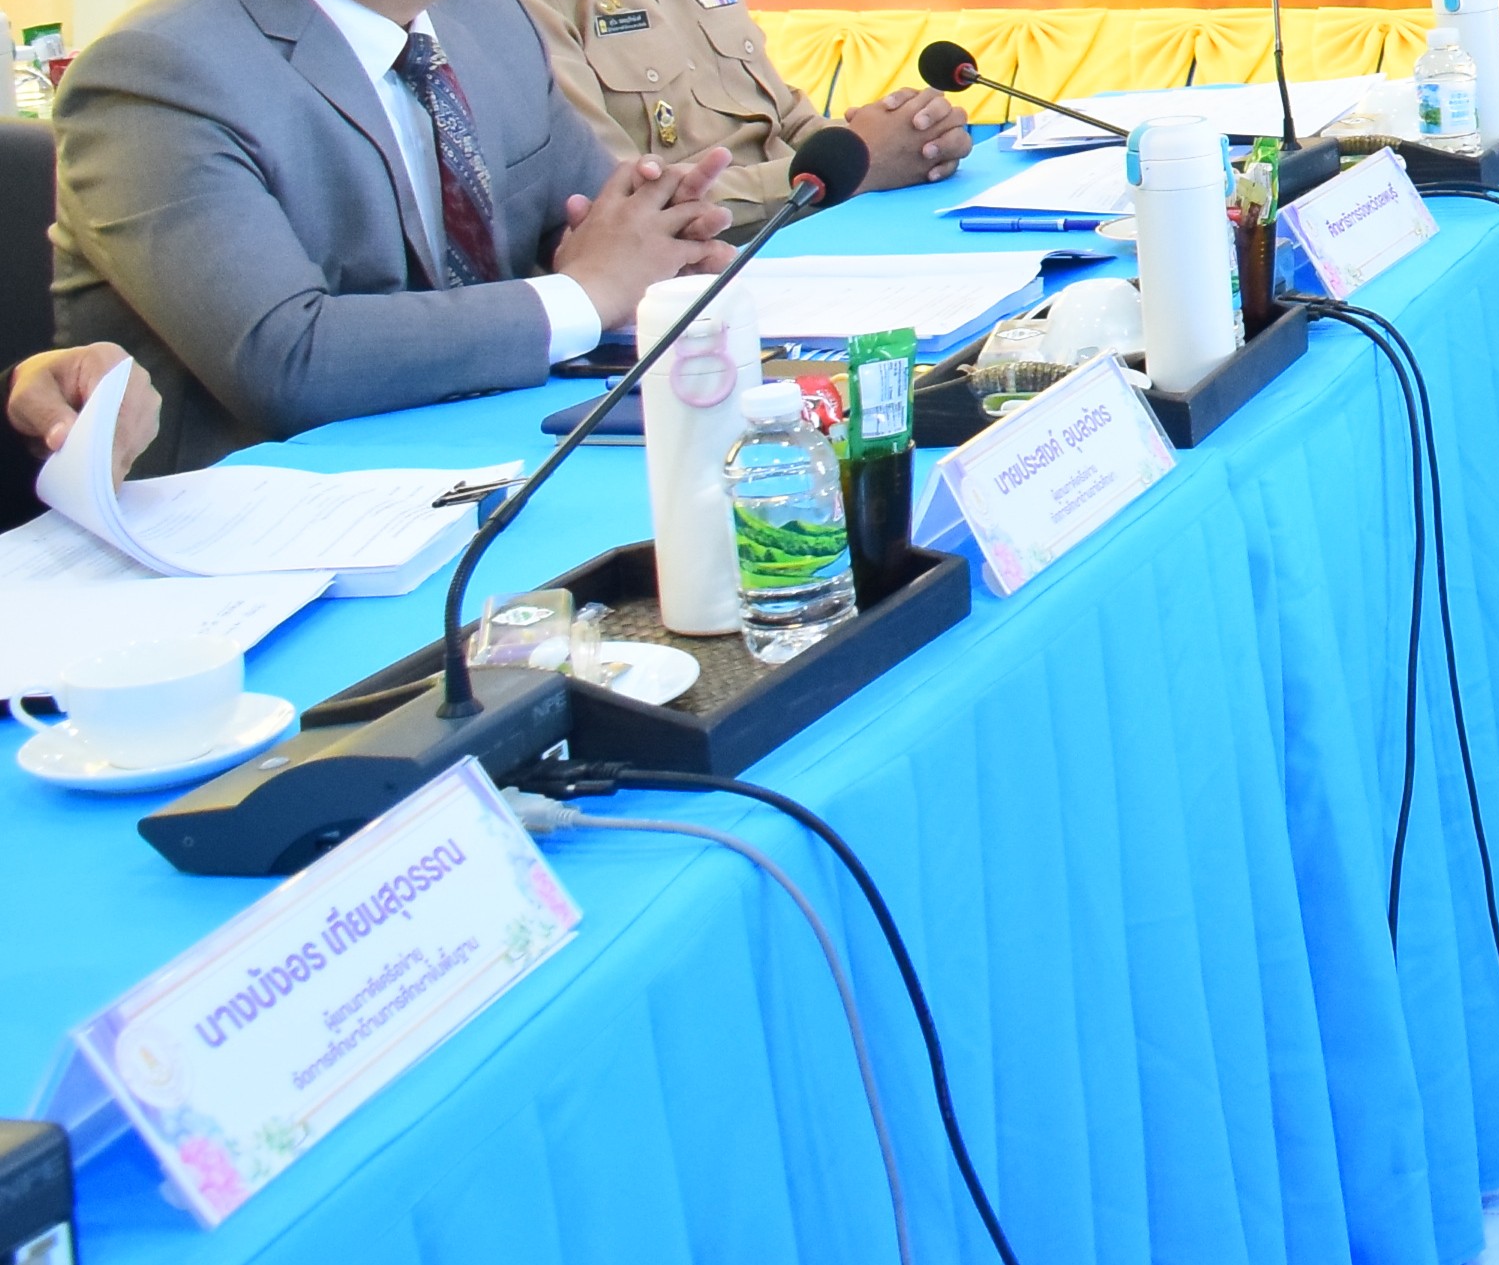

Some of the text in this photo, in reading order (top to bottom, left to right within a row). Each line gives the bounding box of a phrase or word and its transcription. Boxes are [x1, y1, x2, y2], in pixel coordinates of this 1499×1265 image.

[994, 429, 1064, 495] นายประสงค์
[195, 837, 468, 1049] นางบังอร เทียนสุวรรณ
